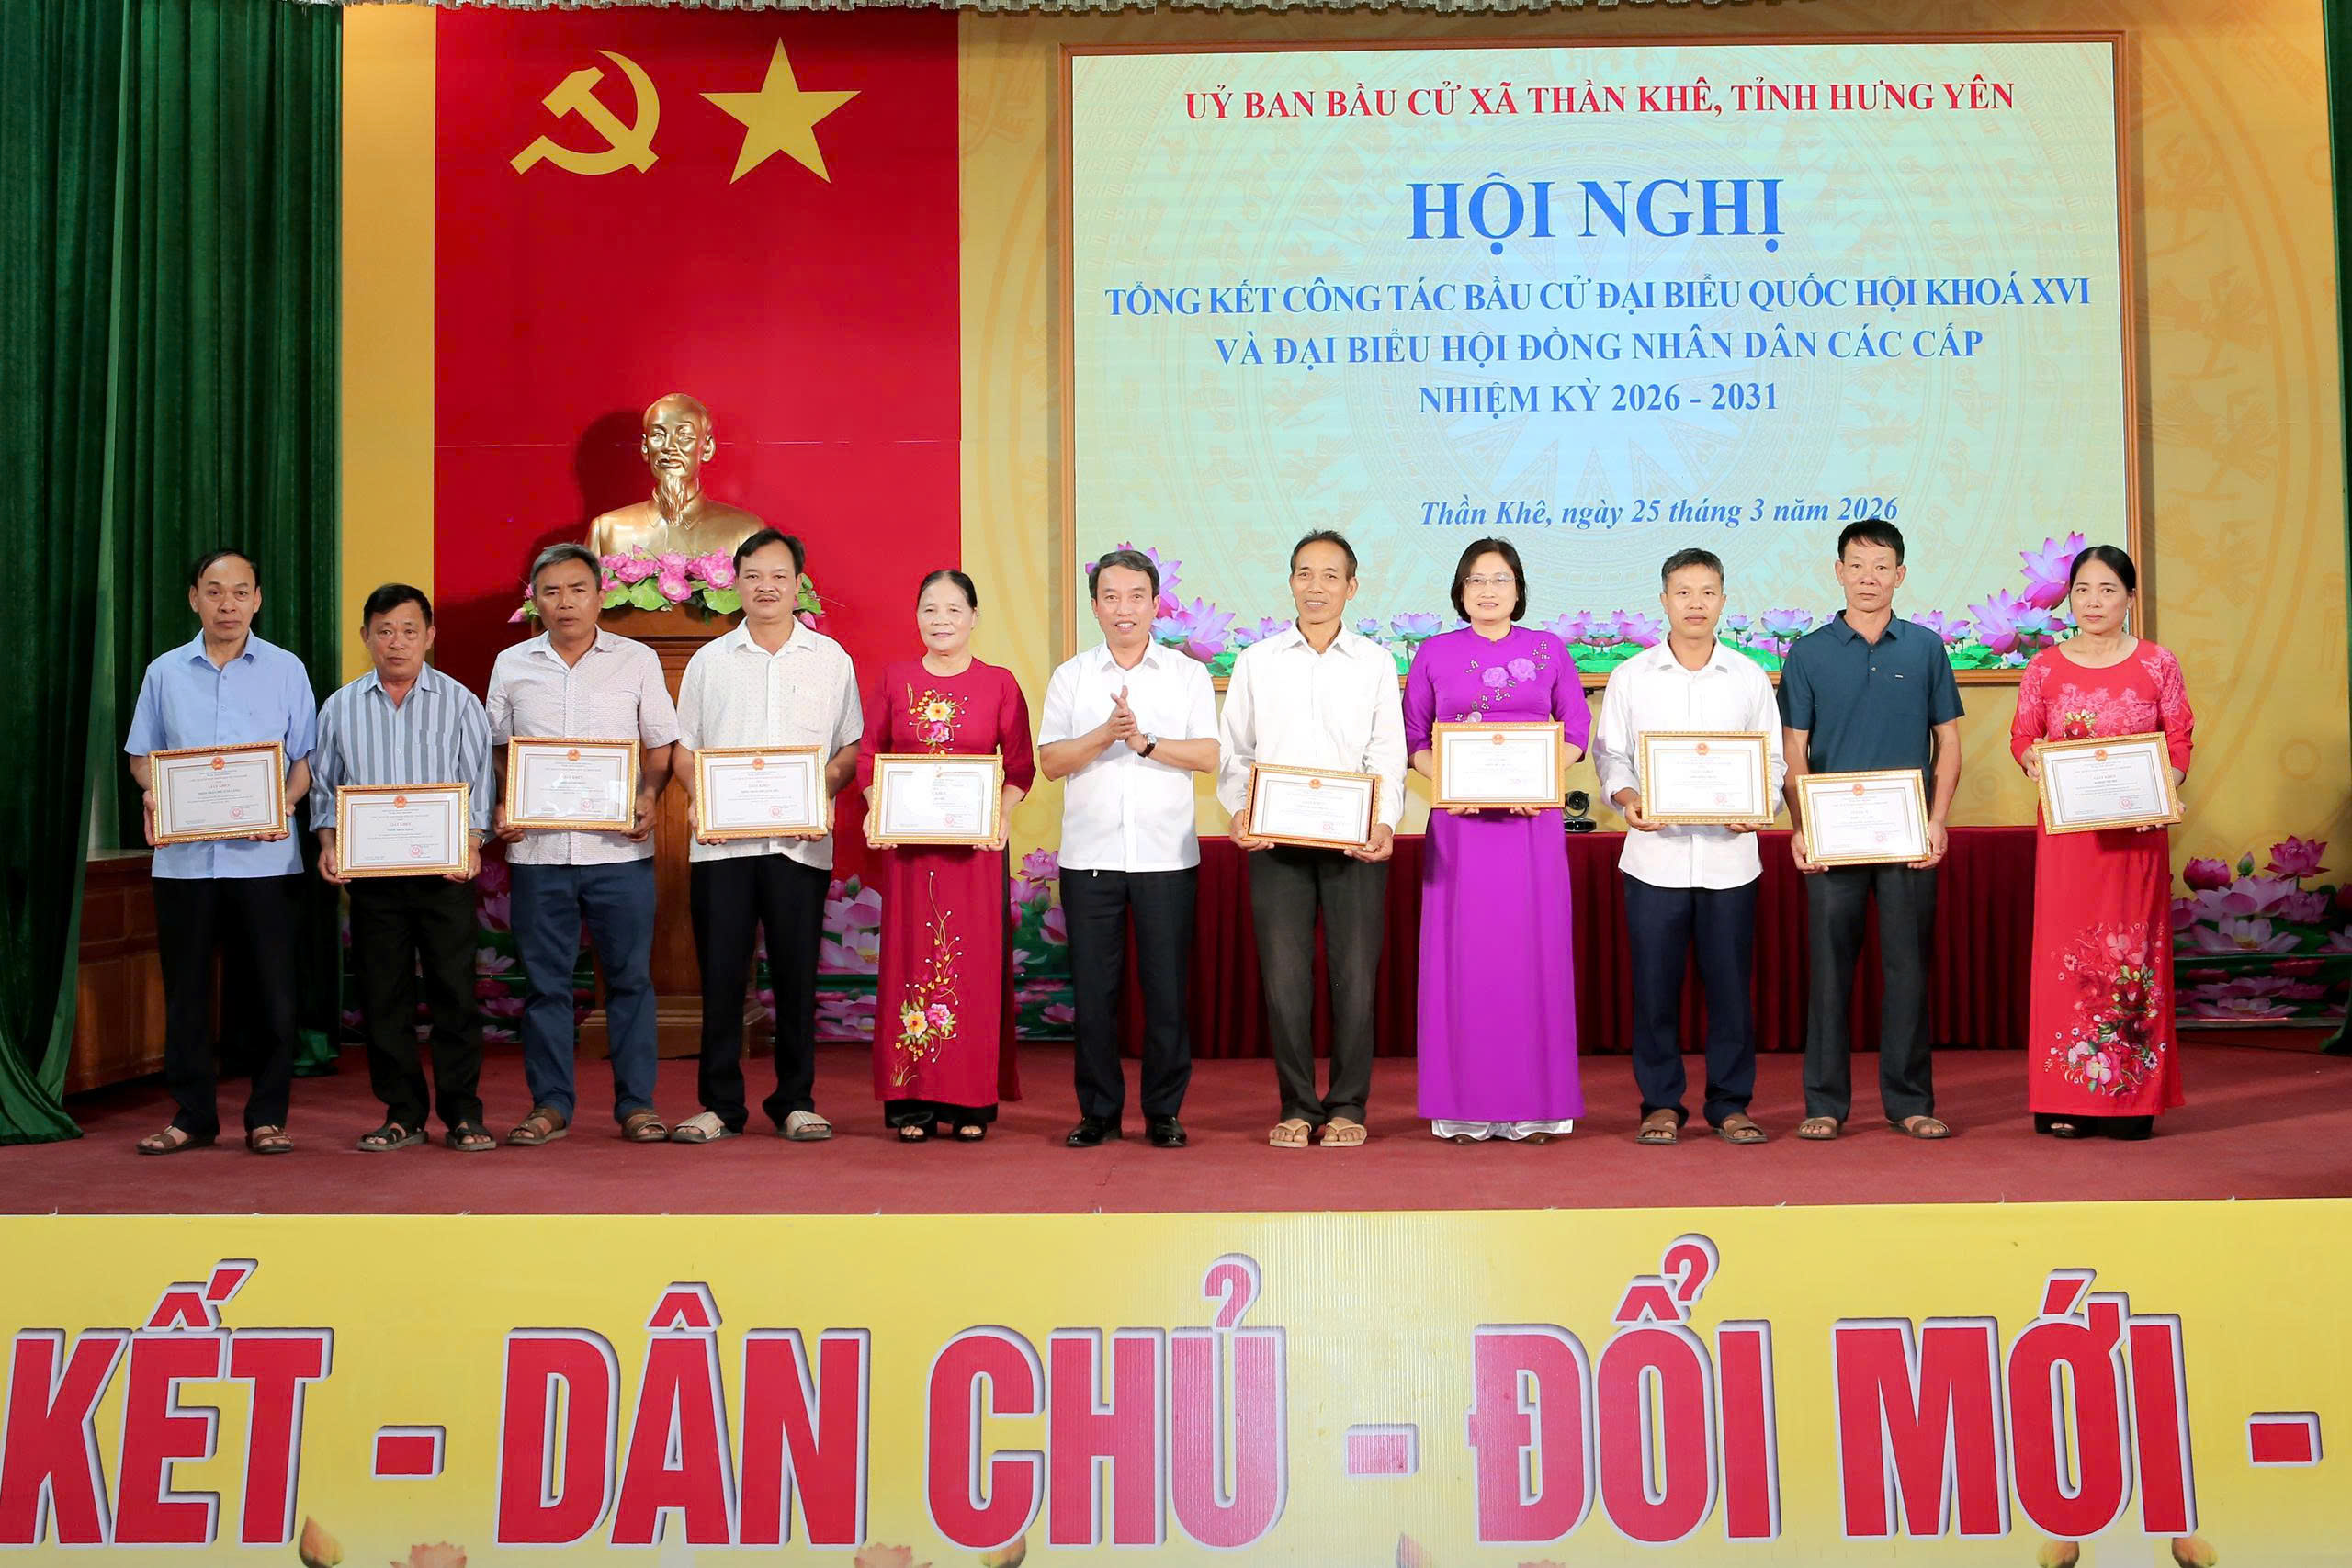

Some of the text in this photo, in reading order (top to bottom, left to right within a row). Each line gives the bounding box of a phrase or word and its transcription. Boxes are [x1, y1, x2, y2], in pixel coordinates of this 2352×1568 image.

[1185, 73, 2014, 119] UỶ BAN BẦU CỬ XÃ THẦN KHÊ, TỈNH HƯNG YÊN
[1405, 171, 1785, 256] HỘI NGHỊ
[1104, 271, 2091, 316] TỔNG KẾT CÔNG TÁC BẦU CỬ ĐẠI BIỂU QUỐC HỘI KHOÁ XVI
[1215, 322, 1984, 371] VÀ ĐẠI BIỂU HỘI ĐỒNG NHÂN DÂN CÁC CẤP
[1418, 380, 1541, 420] NHIỆM
[1550, 377, 1602, 412] KỲ
[1611, 383, 1681, 412] 2026
[1710, 382, 1780, 412] 2031
[1420, 493, 1899, 530] Thần Khê, ngày 25 tháng 3 năm 2026
[0, 1233, 2323, 1552] KẾT - DÂN CHỦ - ĐỔI MỚI -
